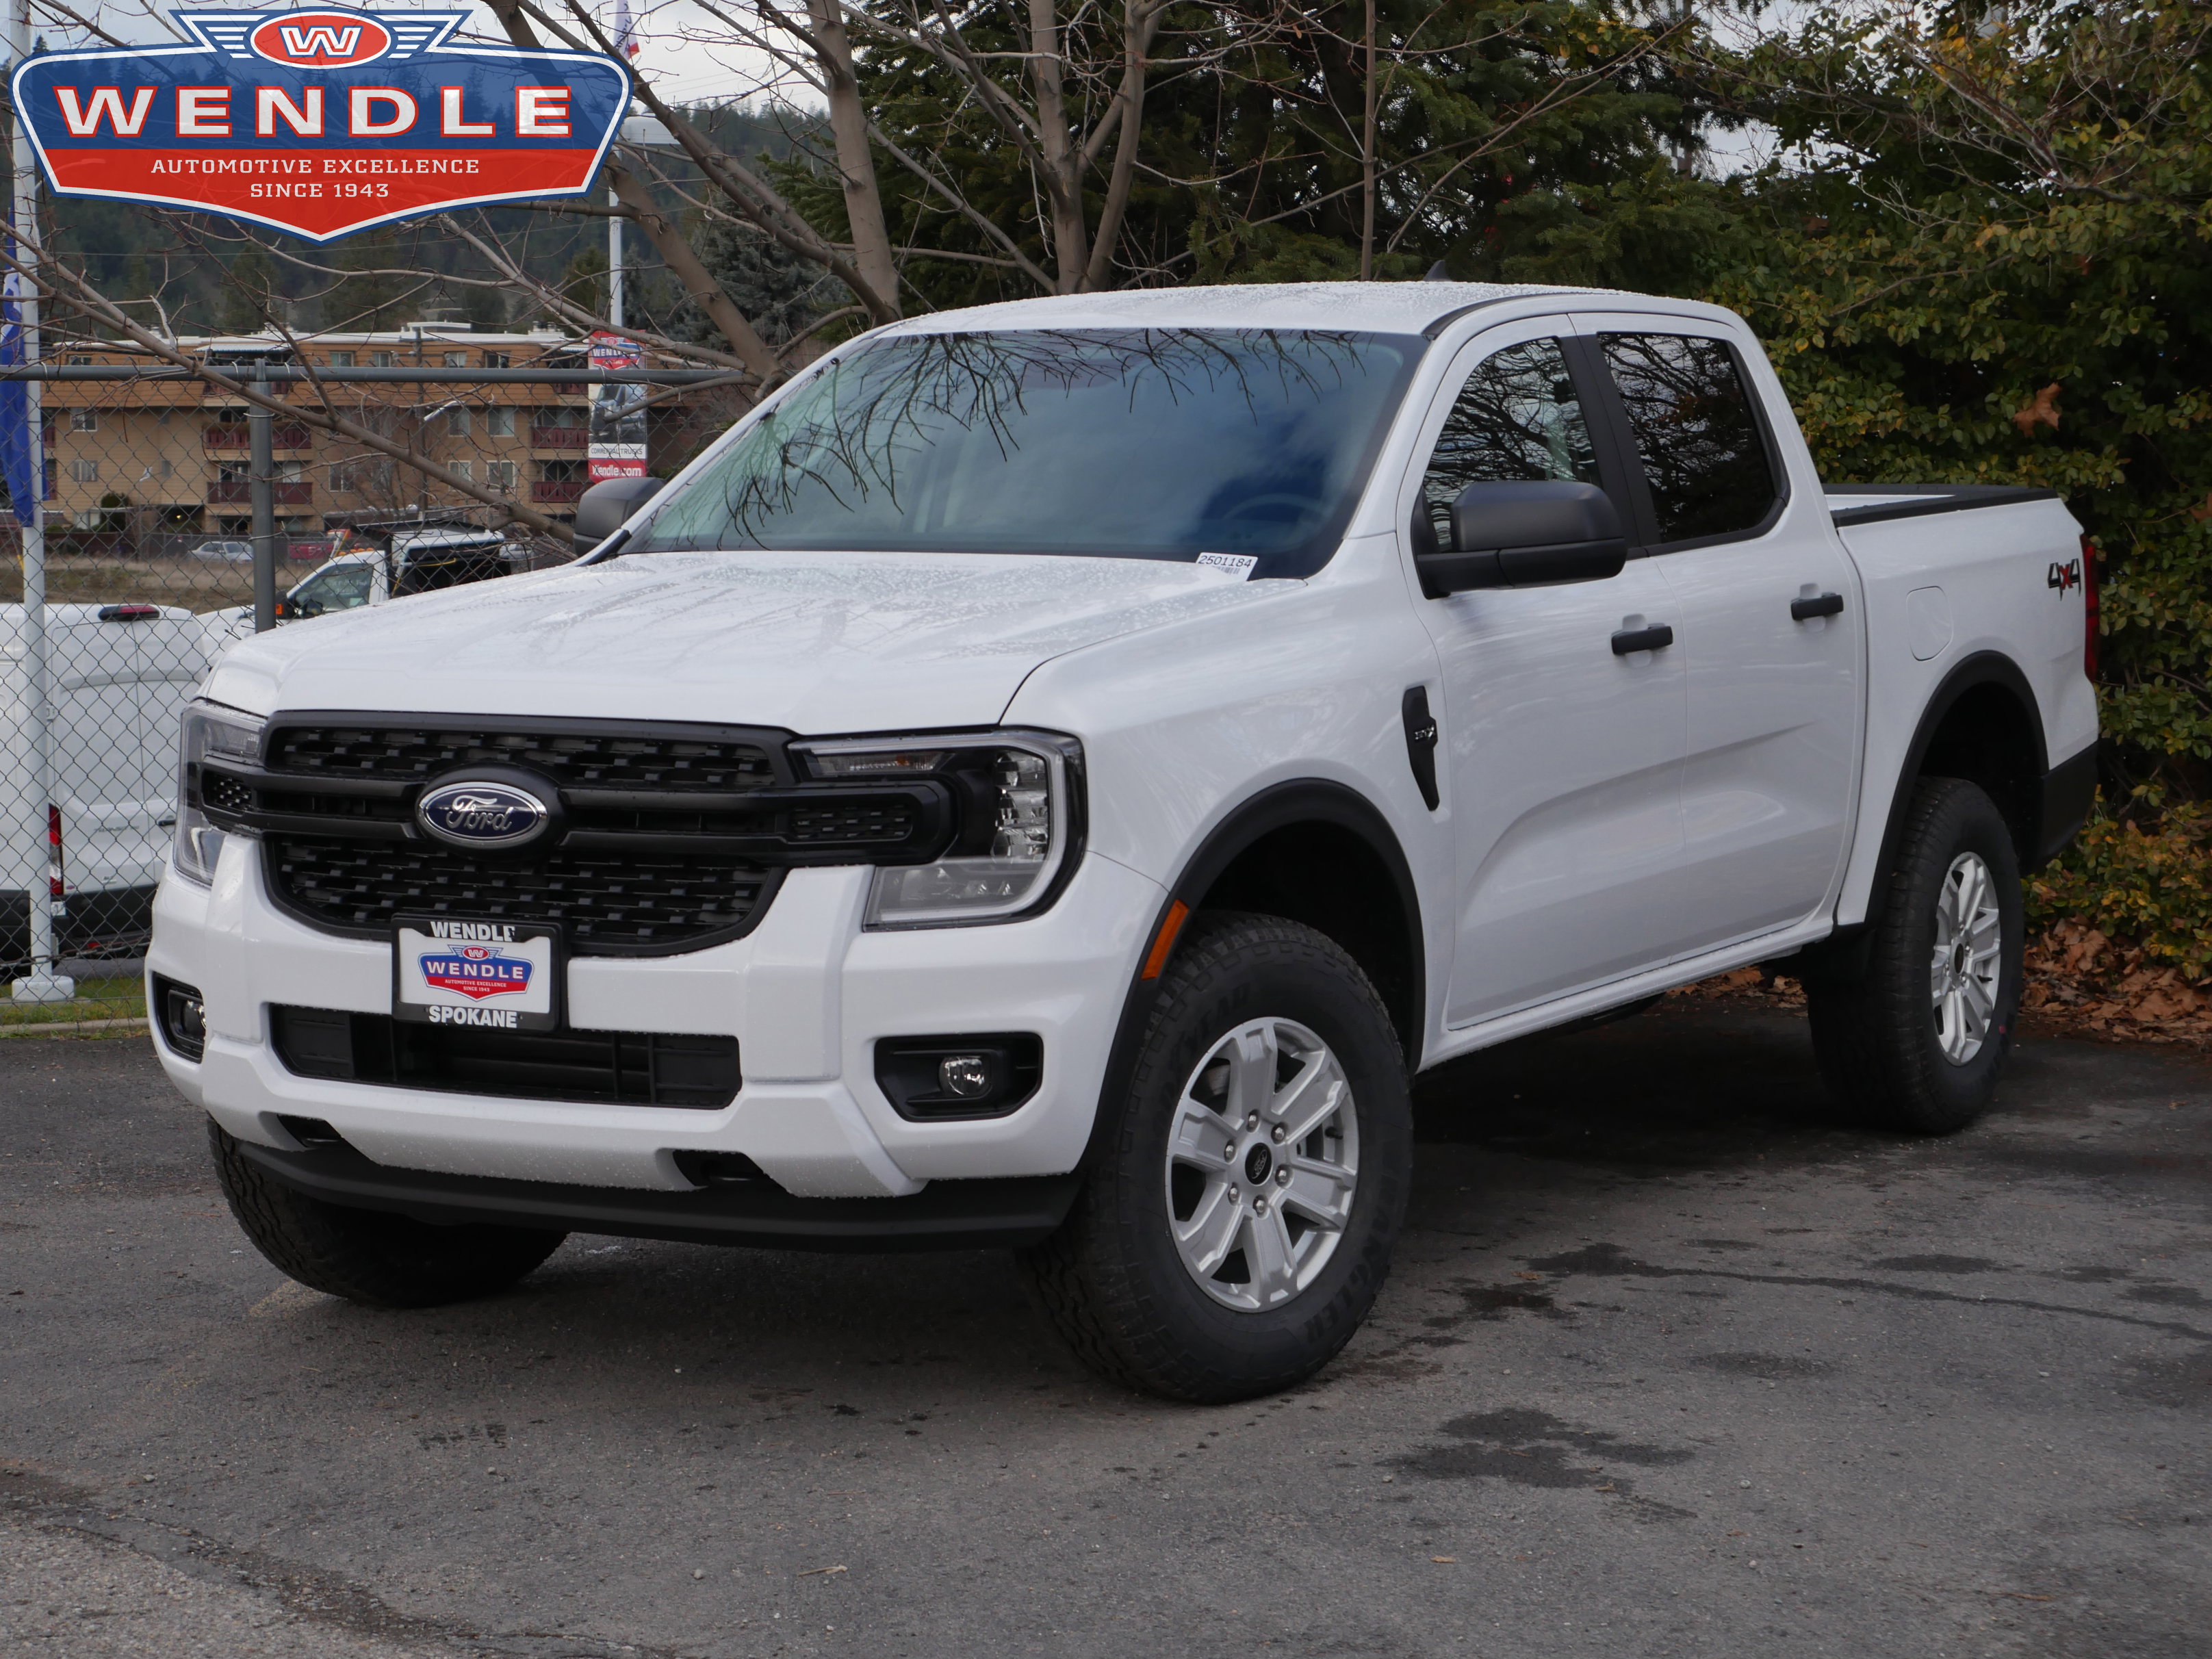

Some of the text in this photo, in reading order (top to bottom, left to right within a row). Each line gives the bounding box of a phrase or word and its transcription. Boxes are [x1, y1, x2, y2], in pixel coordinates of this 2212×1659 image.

[592, 465, 642, 477] Wendle.com
[1198, 555, 1252, 568] 2501184
[446, 795, 515, 832] Ford
[426, 961, 524, 979] WENDLE
[428, 1005, 517, 1029] SPOKANE
